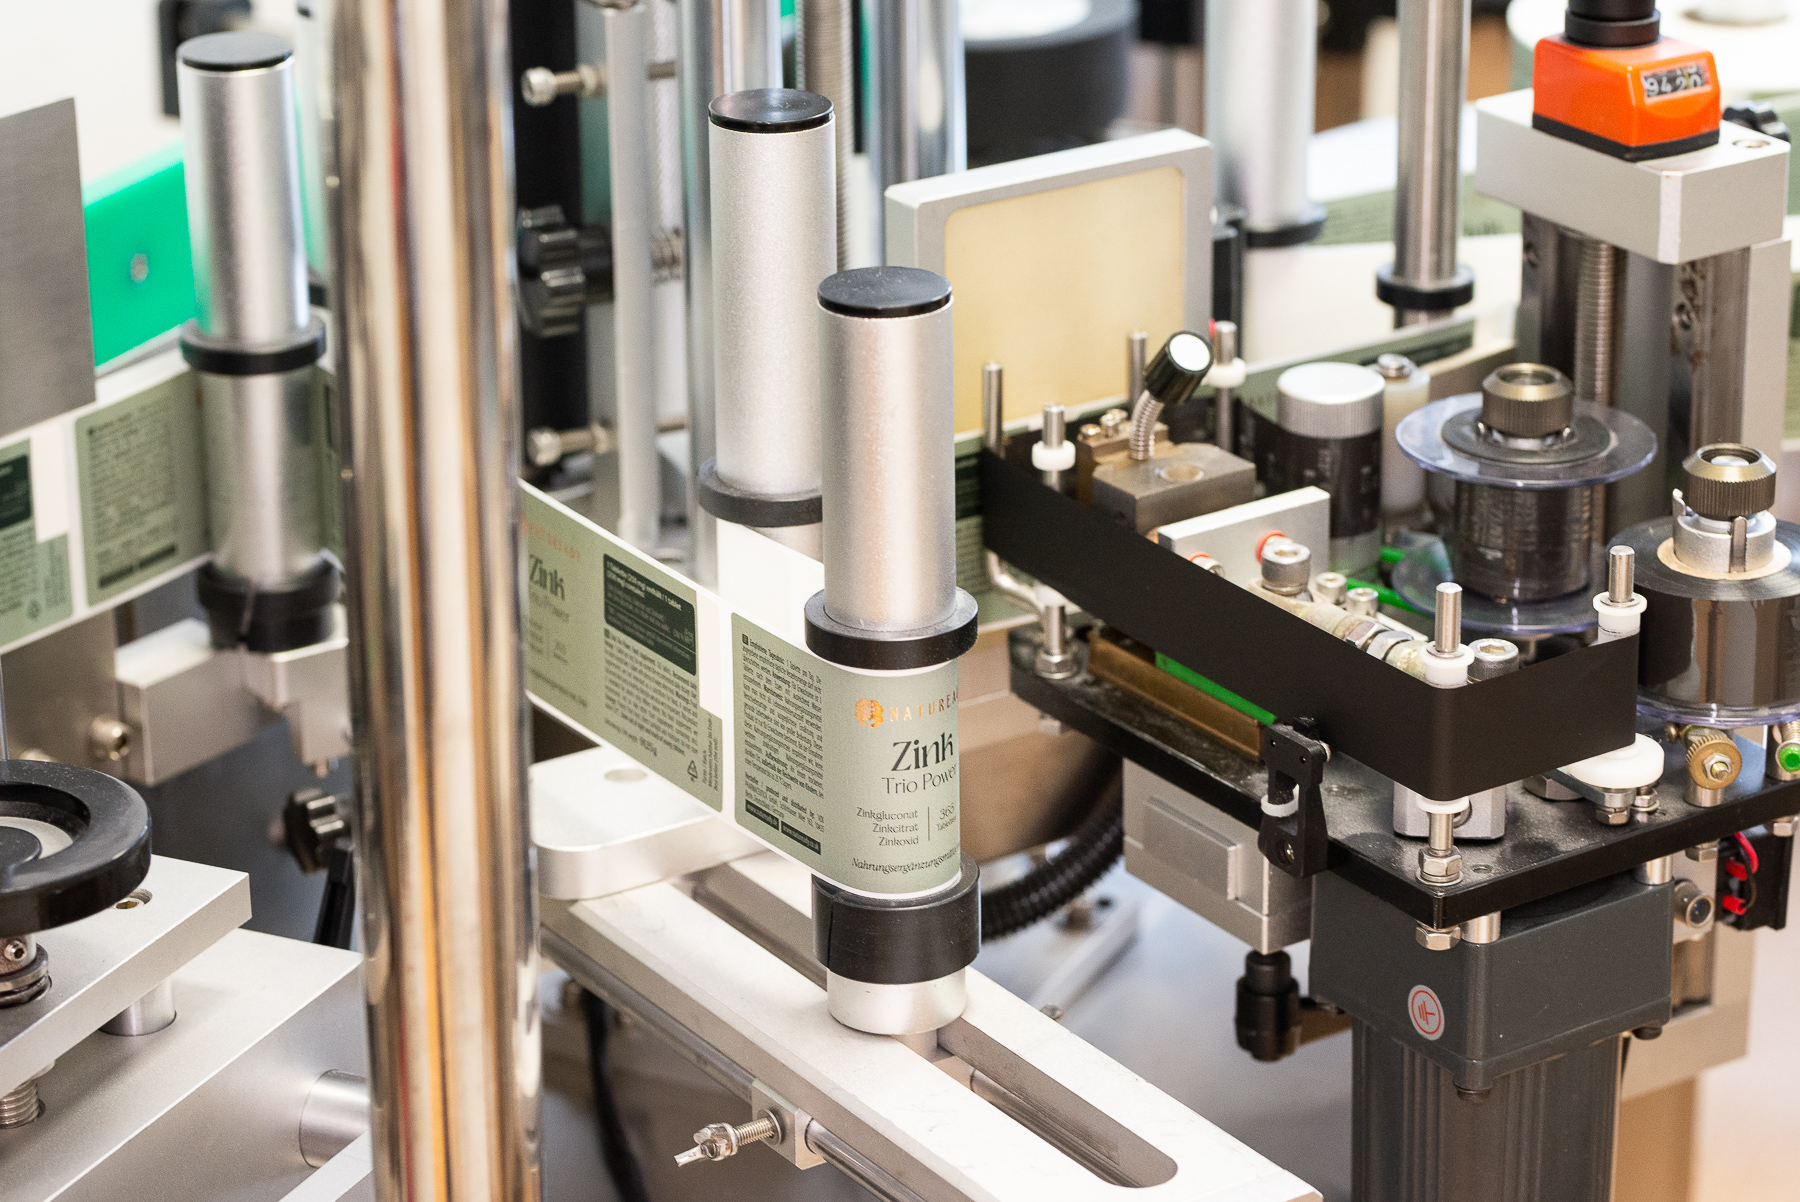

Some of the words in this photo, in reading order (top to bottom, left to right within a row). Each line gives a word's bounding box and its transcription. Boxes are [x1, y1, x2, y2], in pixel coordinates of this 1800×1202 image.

[530, 553, 566, 601] Zink
[891, 732, 954, 771] Zink
[881, 777, 918, 794] Trio
[856, 807, 918, 821] Zinkgluconat
[872, 823, 919, 833] Zinkcitrat
[878, 836, 919, 846] Zinkoxid
